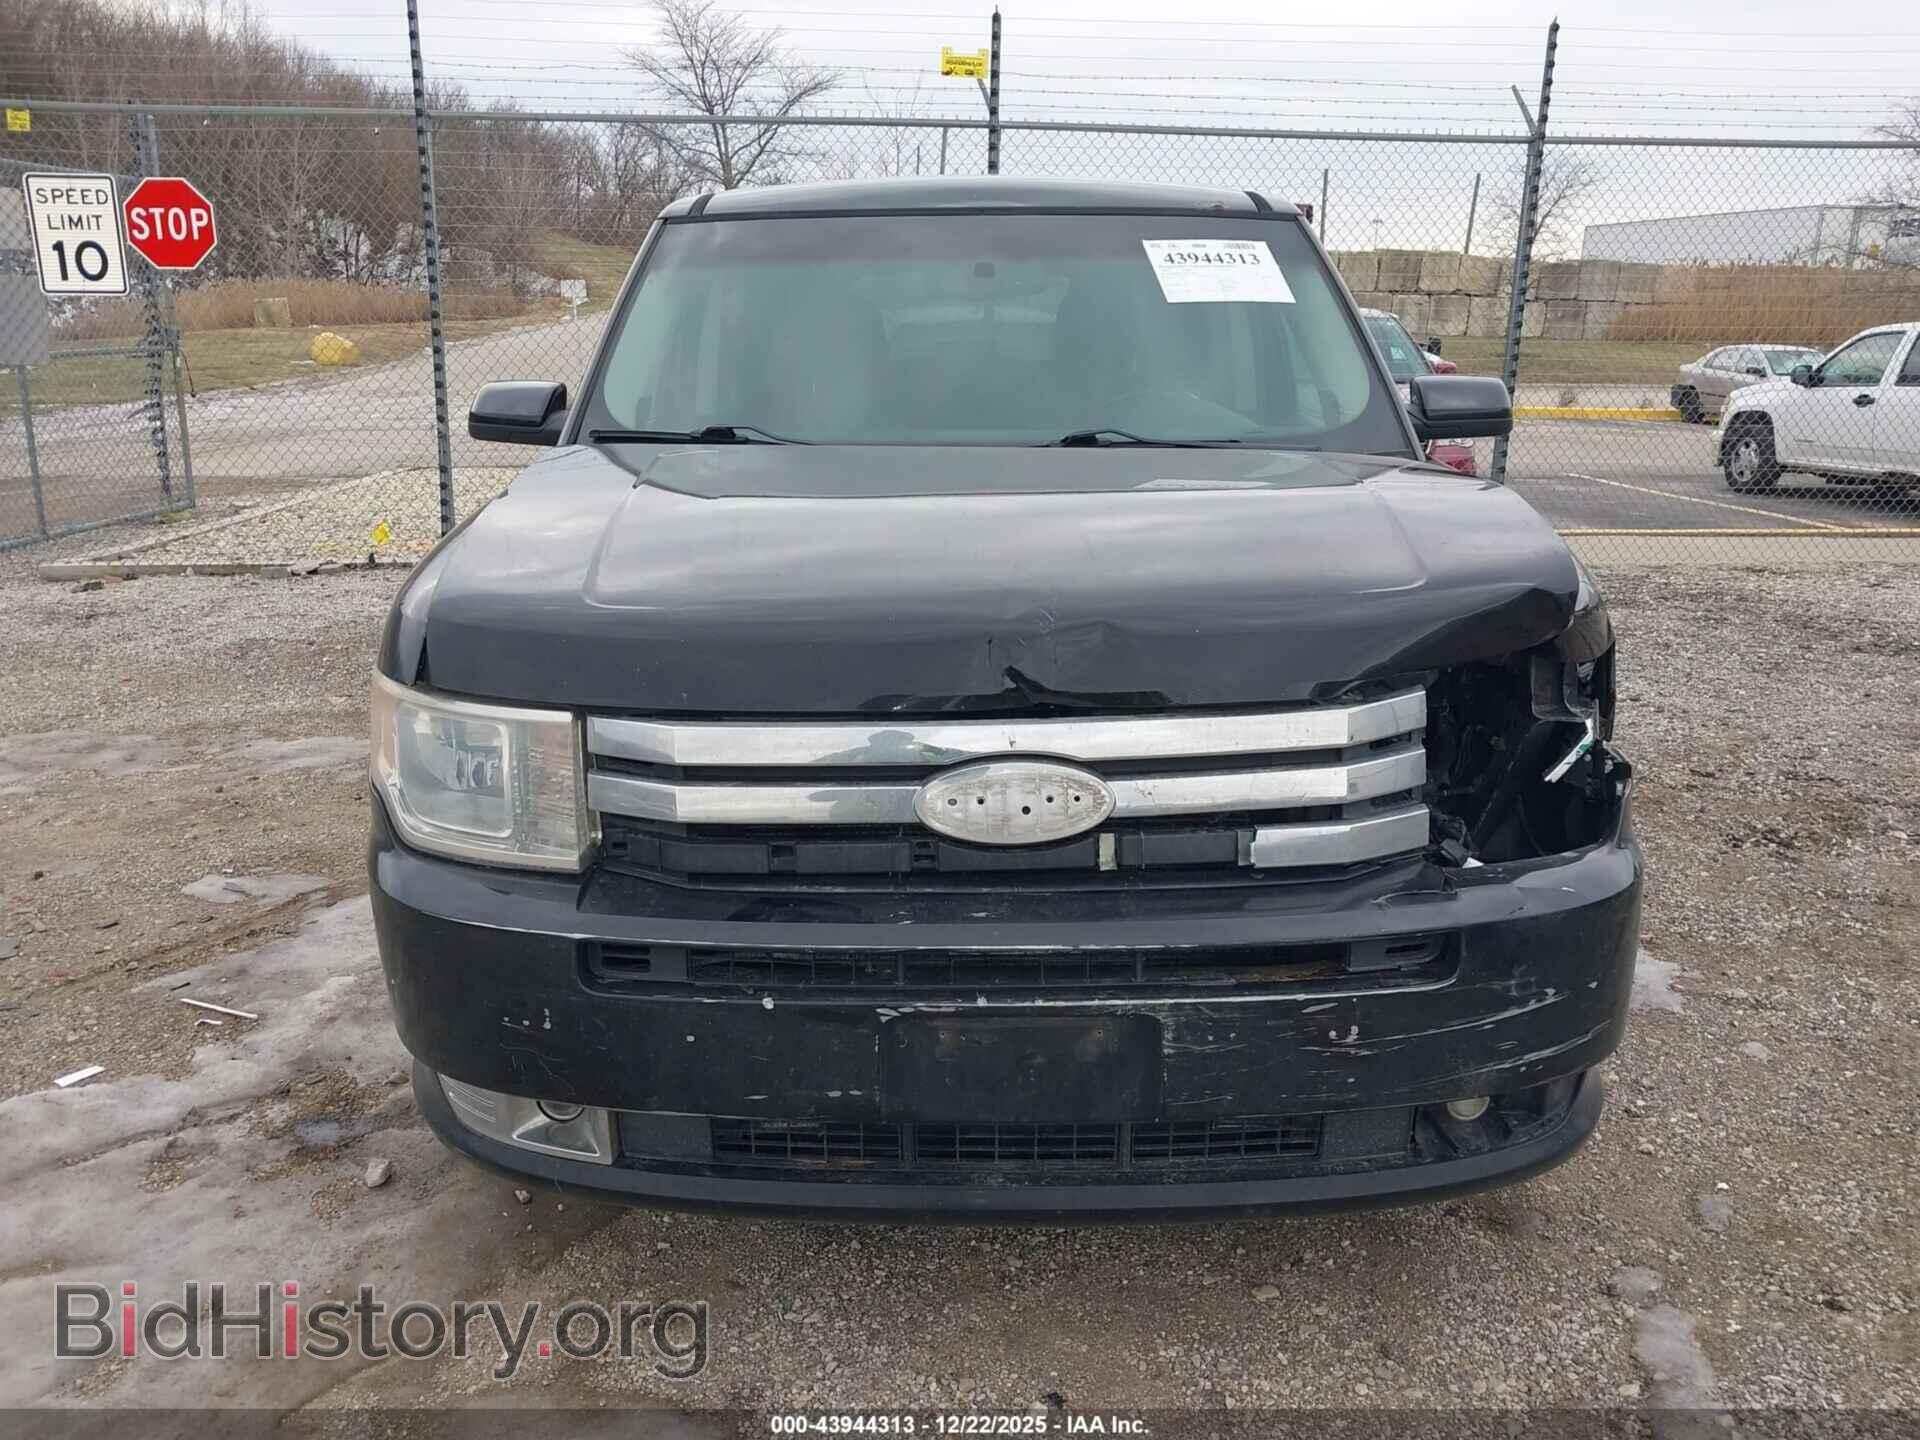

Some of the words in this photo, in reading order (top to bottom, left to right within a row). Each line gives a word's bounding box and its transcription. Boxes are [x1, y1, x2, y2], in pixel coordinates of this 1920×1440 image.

[35, 188, 108, 205] SPEED
[47, 214, 102, 230] LIMIT
[130, 206, 209, 241] STOP
[52, 240, 109, 282] 10
[1164, 252, 1260, 265] 43944313
